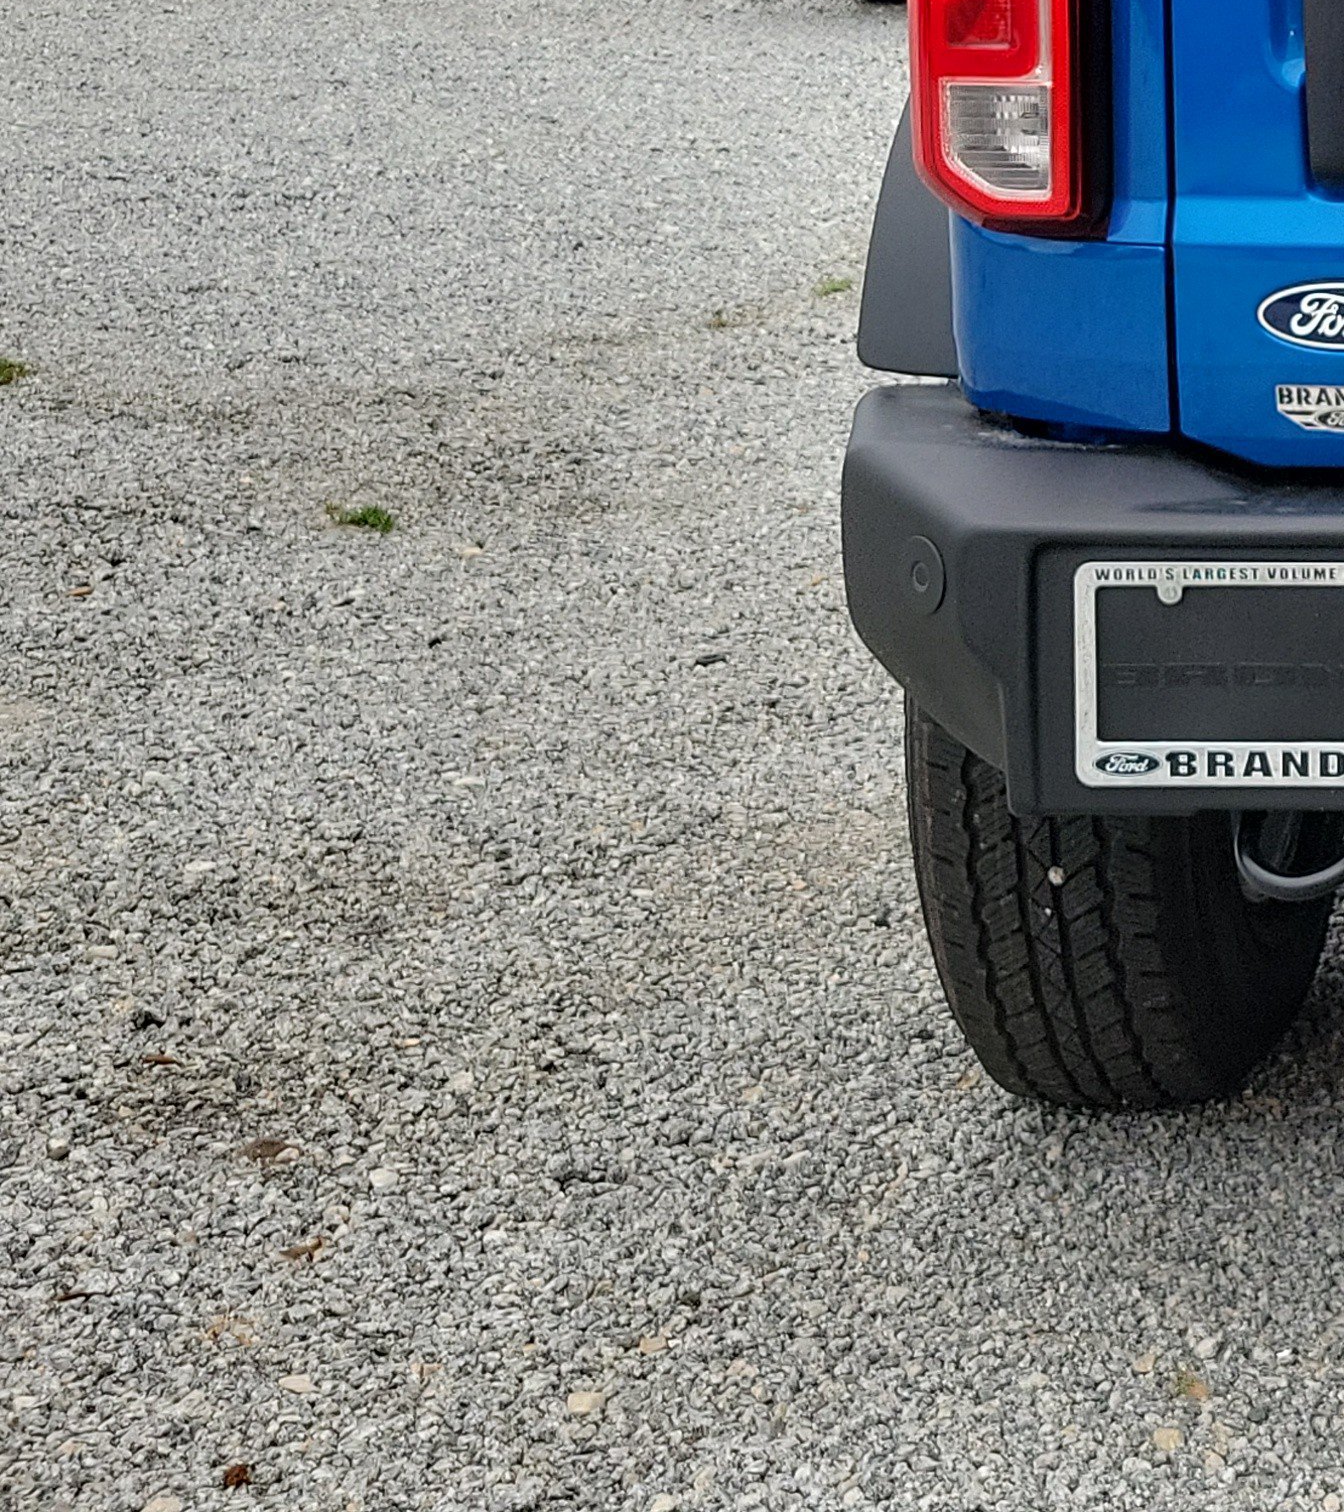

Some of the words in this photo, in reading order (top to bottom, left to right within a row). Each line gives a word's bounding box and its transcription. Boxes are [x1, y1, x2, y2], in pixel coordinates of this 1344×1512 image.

[1095, 567, 1175, 581] WORLD'S
[1183, 567, 1259, 581] LARGEST
[1267, 567, 1336, 581] VOLUME
[1105, 753, 1148, 773] Ford
